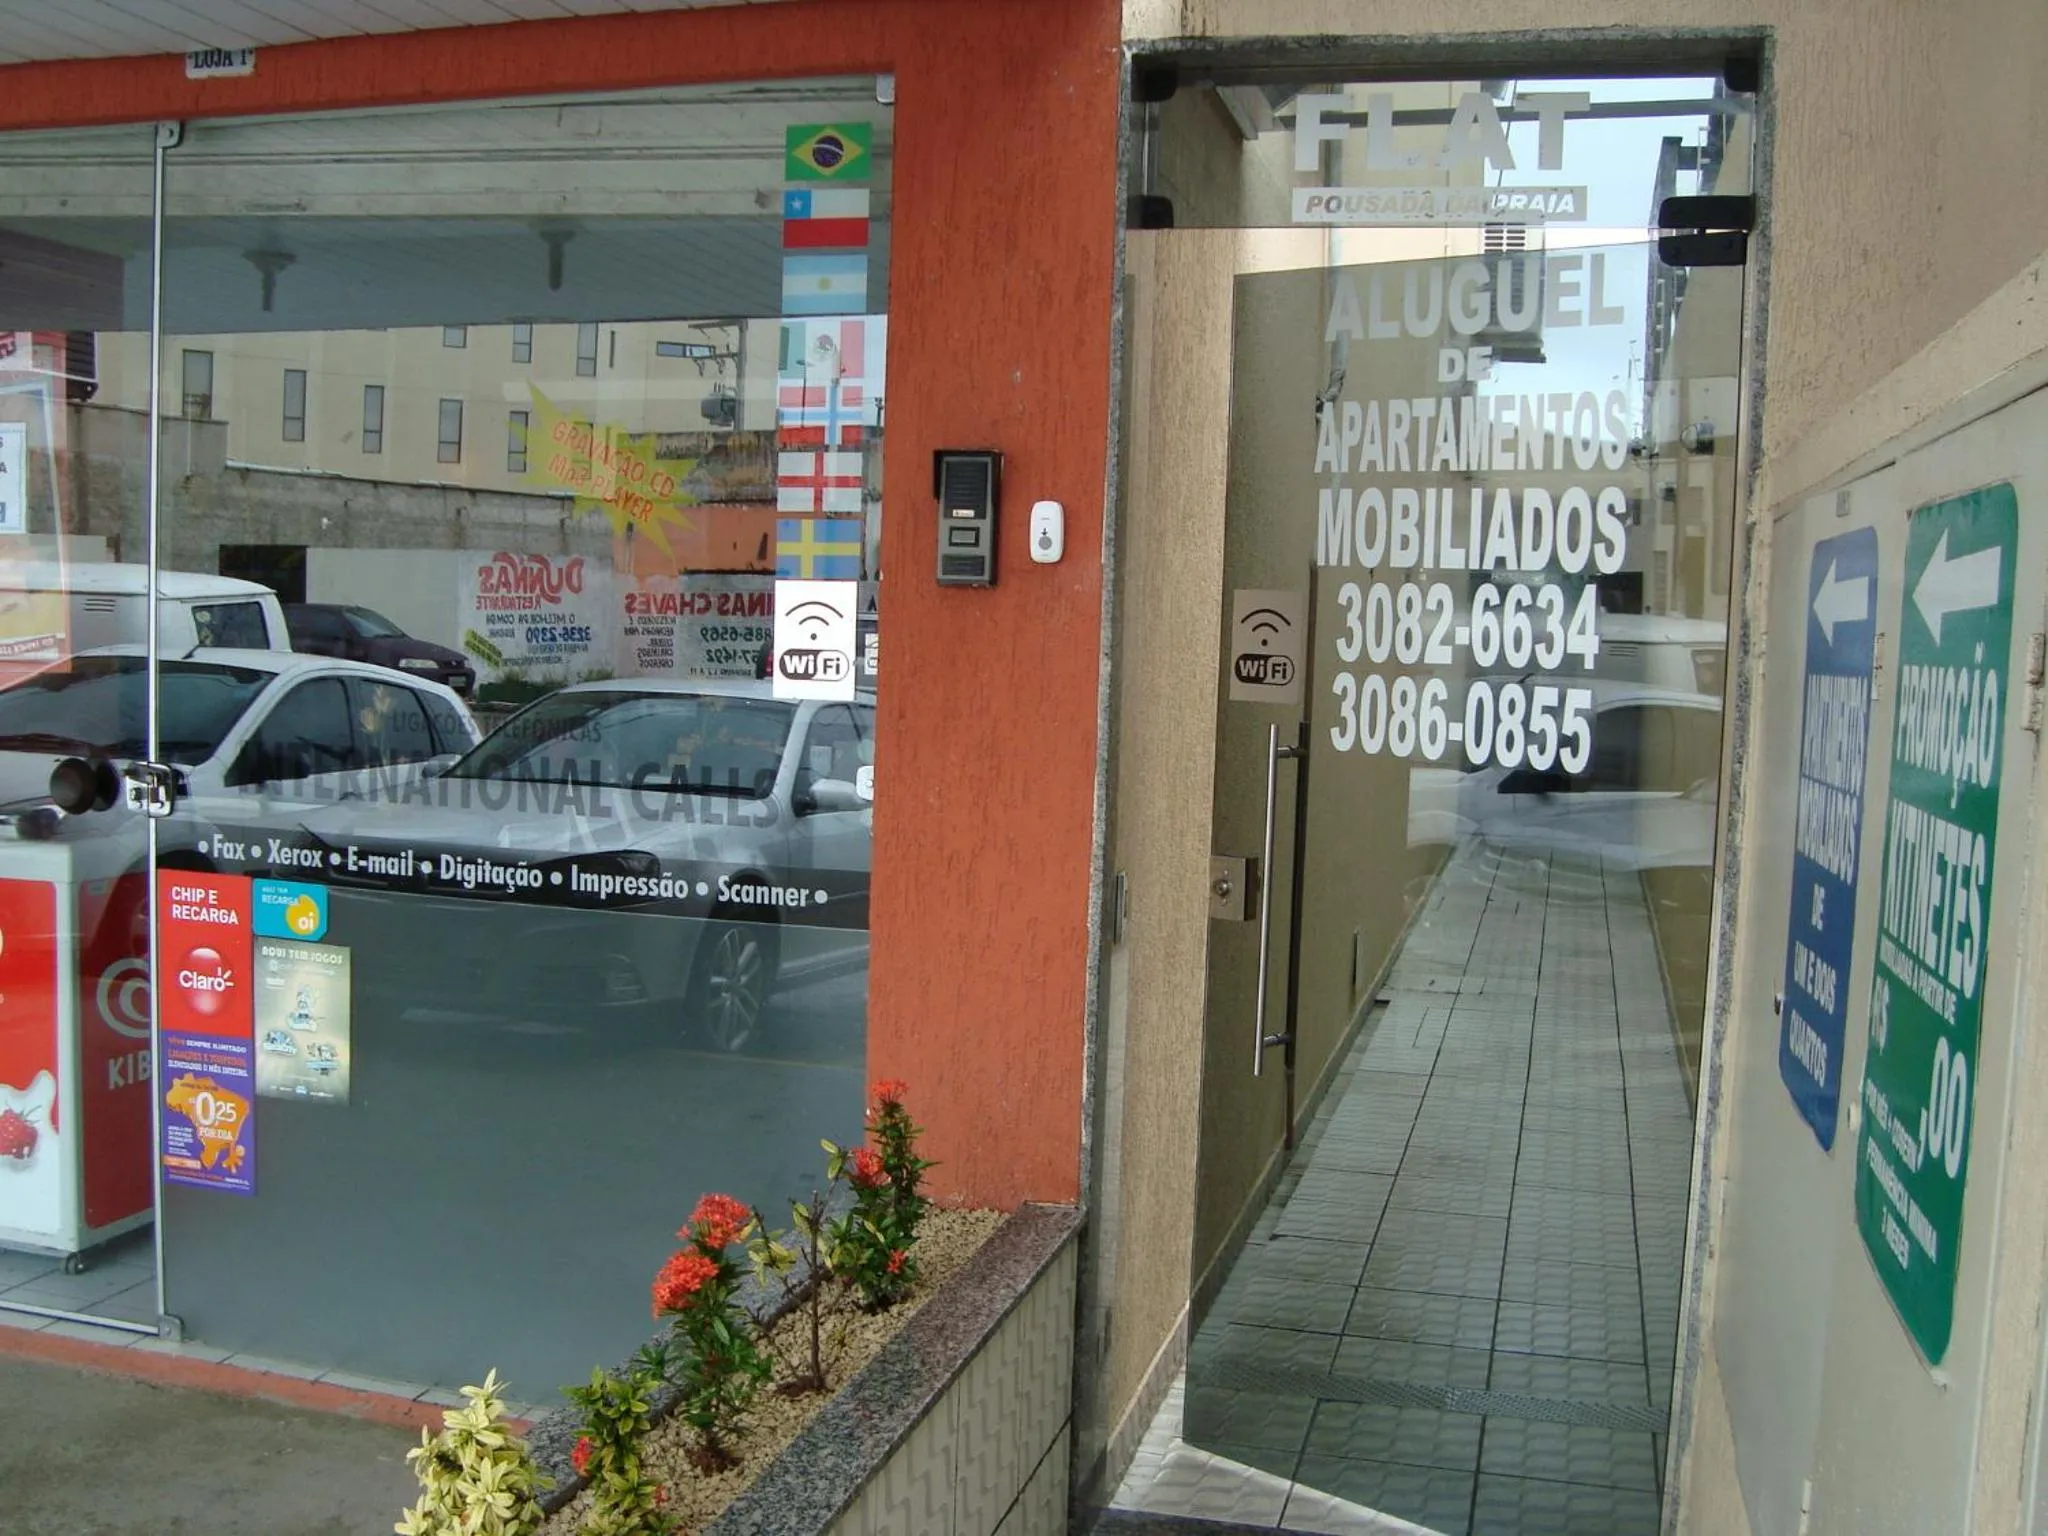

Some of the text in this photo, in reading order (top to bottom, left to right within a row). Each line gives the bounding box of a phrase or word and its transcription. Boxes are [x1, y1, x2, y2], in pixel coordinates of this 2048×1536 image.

[1295, 92, 1590, 171] FLAT
[1305, 194, 1435, 214] POUSADA
[1492, 193, 1576, 214] PRAIA
[1324, 254, 1624, 342] ALUGUEL
[1438, 346, 1493, 382] DE
[1314, 390, 1629, 473] APARTAMENTOS
[590, 474, 654, 525] PLAYER
[650, 470, 676, 499] CD
[1317, 486, 1626, 574] MOBILIADOS
[1336, 582, 1599, 670] 3082-6634
[781, 651, 845, 678] WiFi
[1237, 657, 1289, 683] WiFi
[1330, 672, 1592, 774] 3086-0855
[1896, 640, 1998, 809] PROMOÇÃO
[238, 740, 779, 828] INTERNATIONAL CALLS
[172, 886, 218, 905] CHIP E
[213, 833, 809, 907] Fax Xerox E-mail Digitação Impressão Scanner
[1884, 797, 1985, 998] KITINETES
[172, 904, 239, 925] RECARGA
[1811, 883, 1825, 932] DE
[178, 970, 227, 992] Claro
[262, 946, 286, 958] AQUI
[1807, 950, 1814, 993] E
[1813, 955, 1837, 1016] DOIS
[1789, 1008, 1828, 1089] QUARTOS
[196, 1091, 237, 1127] 0,25
